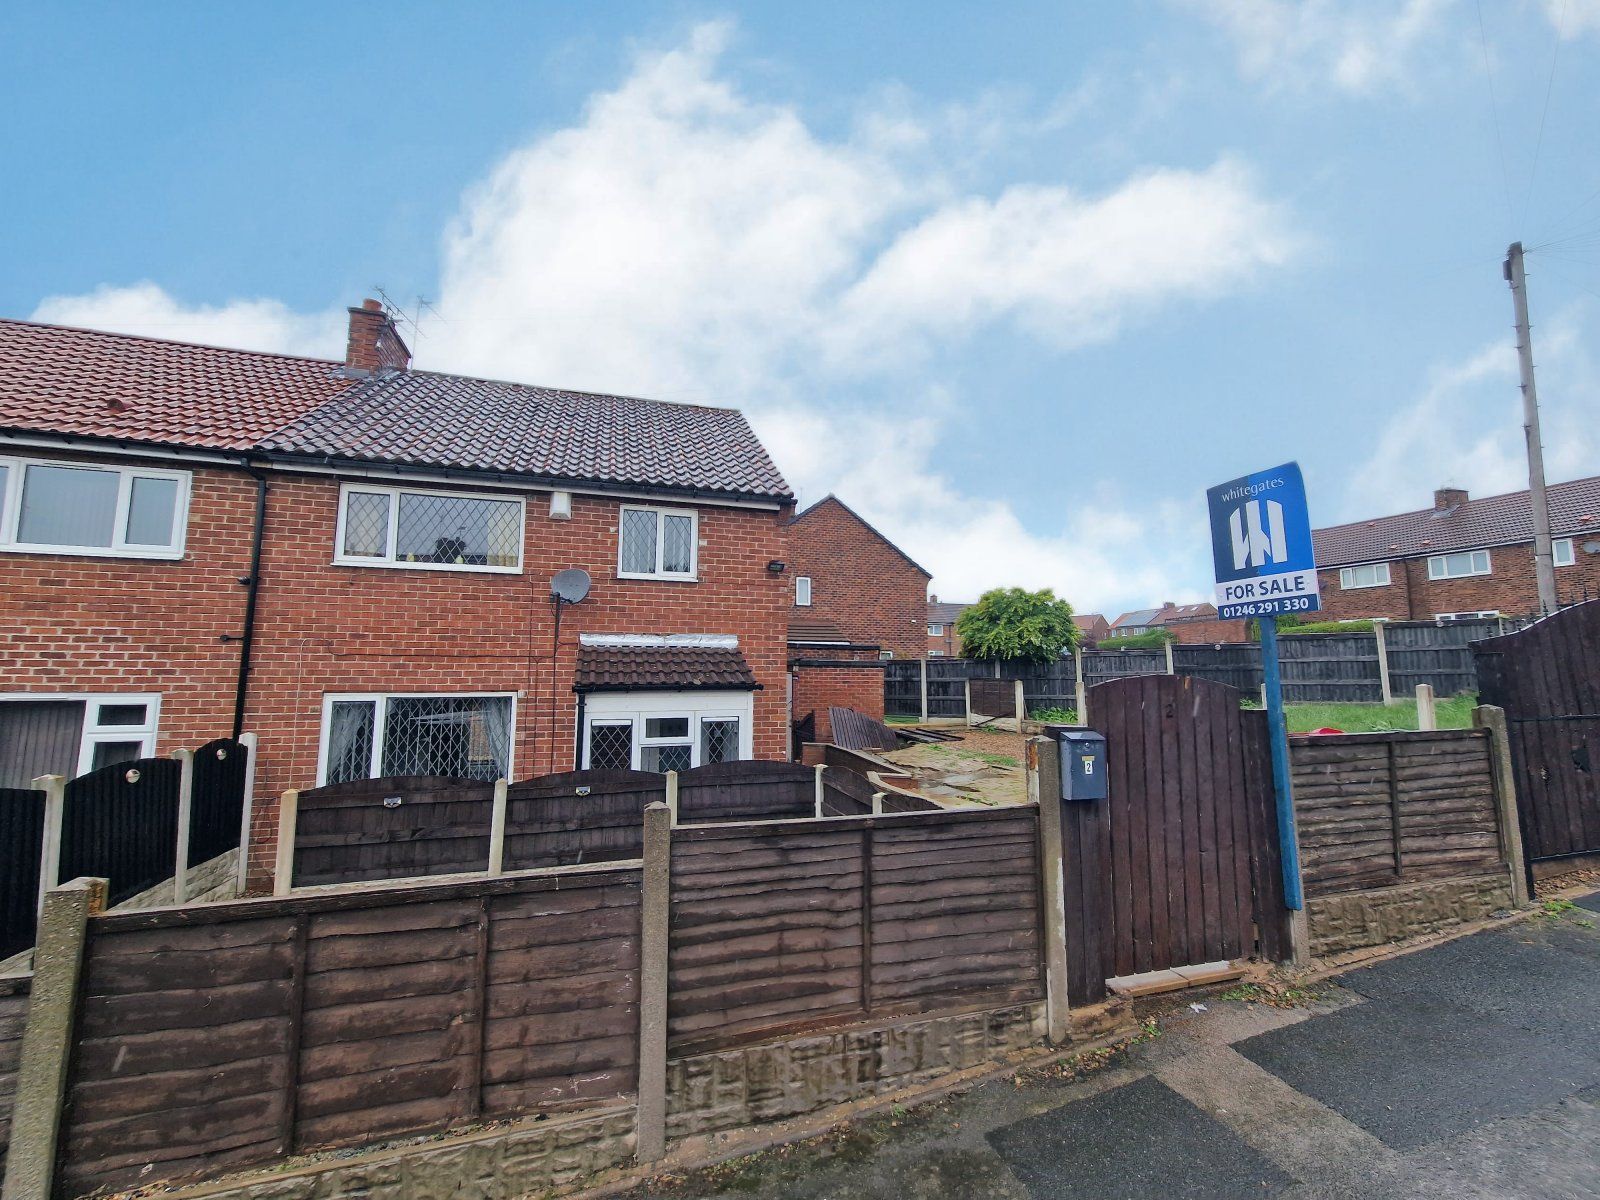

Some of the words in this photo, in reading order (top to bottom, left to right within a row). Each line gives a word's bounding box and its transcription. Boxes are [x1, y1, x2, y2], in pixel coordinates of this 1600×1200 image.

[1222, 477, 1284, 502] whitegates
[1226, 584, 1255, 600] FOR
[1259, 575, 1305, 596] SALE
[1223, 605, 1256, 618] 01246
[1257, 602, 1279, 613] 291
[1284, 598, 1309, 611] 330
[1086, 762, 1092, 773] 2
